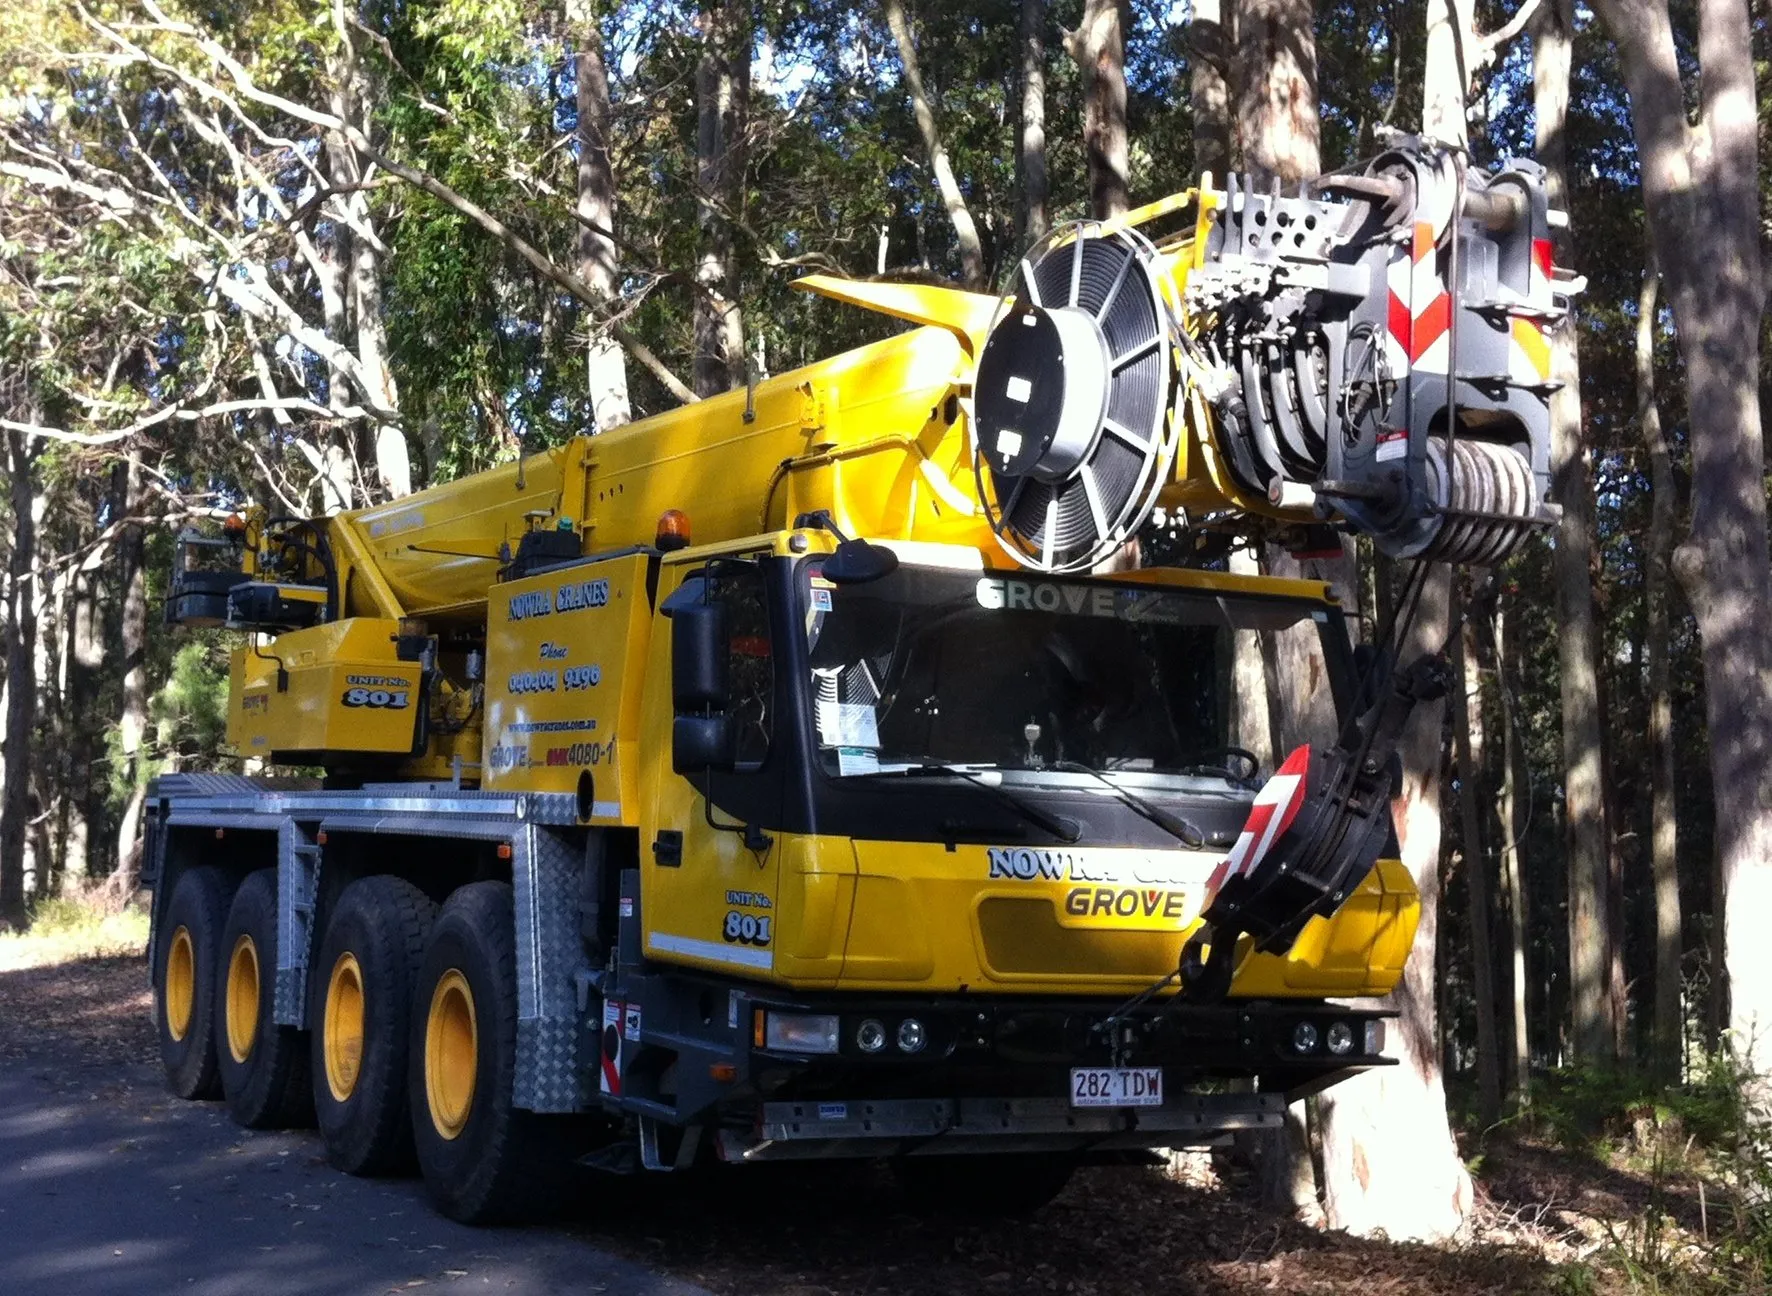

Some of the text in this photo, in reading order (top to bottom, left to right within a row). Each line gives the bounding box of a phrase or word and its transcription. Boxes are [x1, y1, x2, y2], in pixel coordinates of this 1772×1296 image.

[554, 578, 609, 613] CRANES
[975, 577, 1116, 617] GROVE
[540, 642, 567, 660] Phone
[347, 674, 385, 686] UNIT
[341, 687, 410, 709] 801
[489, 744, 528, 768] GROVE
[726, 890, 752, 905] UNIT
[1065, 886, 1186, 918] GROVE
[722, 910, 772, 946] 801
[1075, 1071, 1159, 1097] 282 TDW
